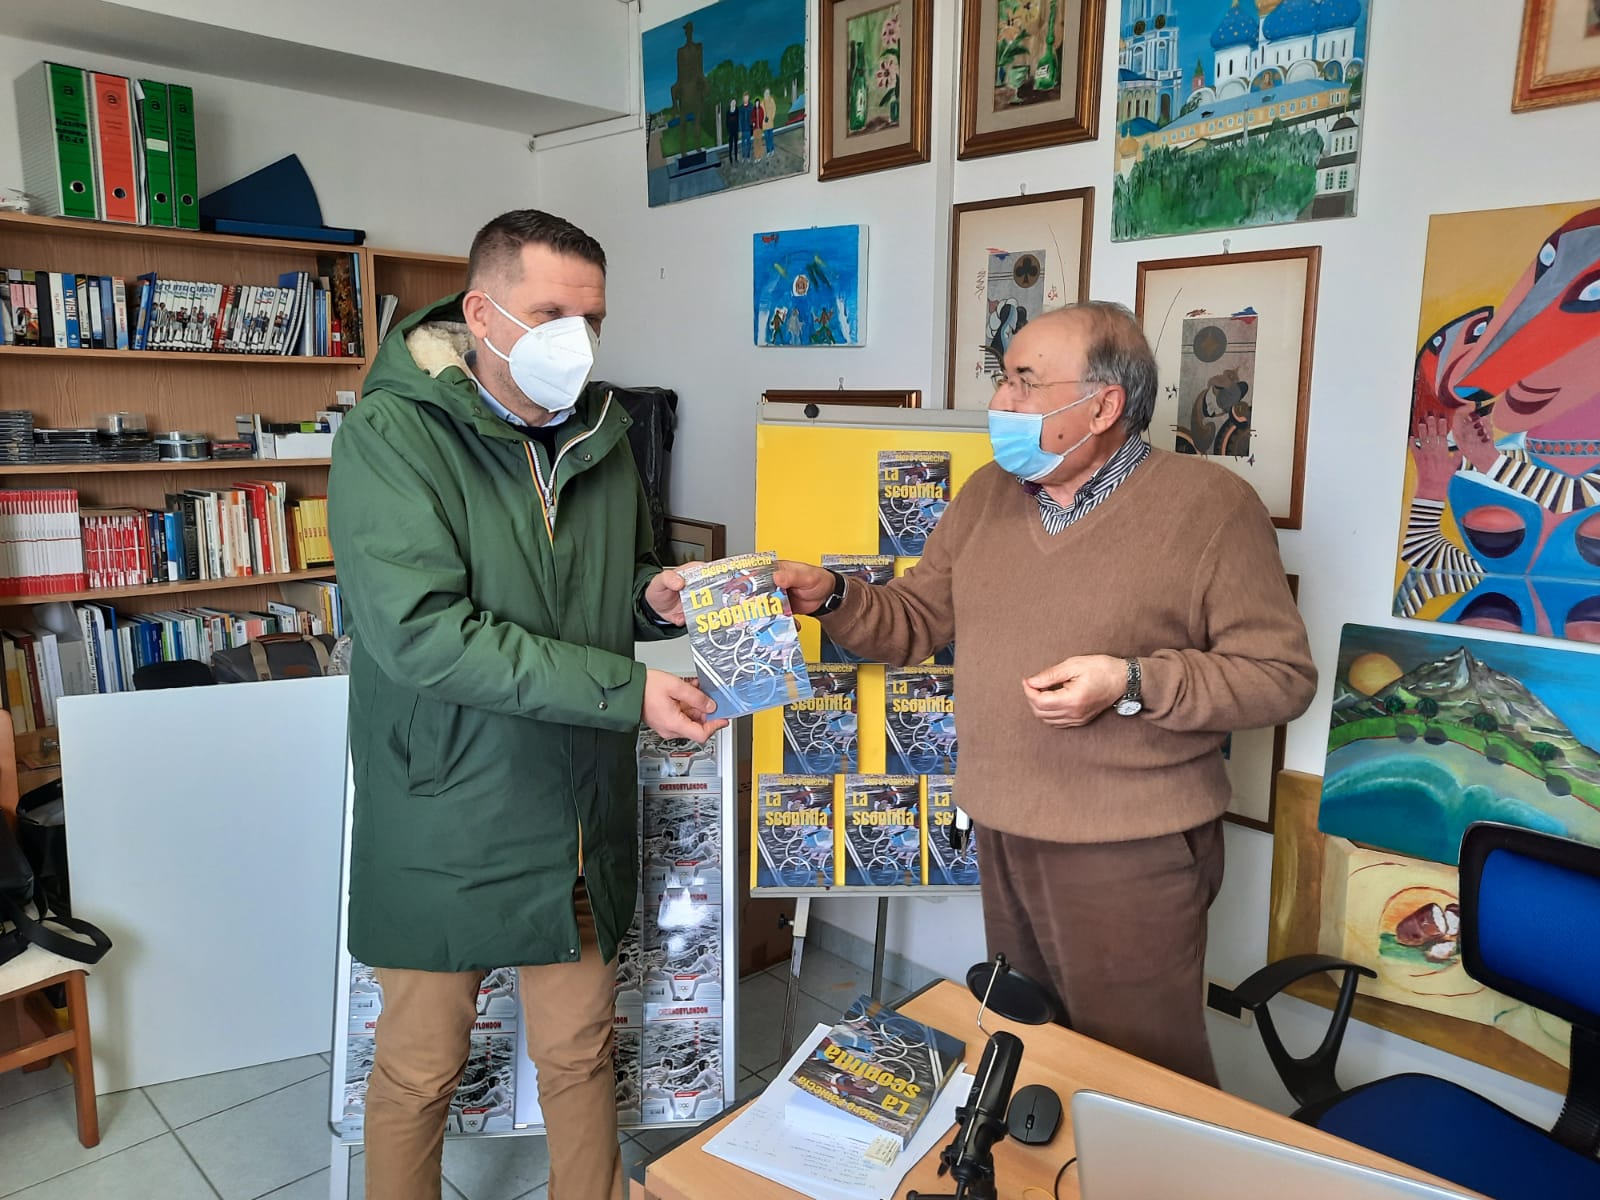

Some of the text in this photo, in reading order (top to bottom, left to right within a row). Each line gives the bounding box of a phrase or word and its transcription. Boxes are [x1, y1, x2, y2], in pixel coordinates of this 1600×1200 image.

[65, 297, 77, 321] VIGILE
[884, 466, 899, 481] La
[884, 483, 943, 499] sconfitta
[689, 587, 714, 610] La
[695, 595, 784, 634] sconfitta
[893, 680, 908, 695] La
[765, 791, 782, 807] La
[852, 791, 868, 807] La
[934, 791, 950, 807] La
[765, 811, 828, 827] sconfitta
[852, 811, 915, 826] sconfitta
[824, 1044, 920, 1098] sconfitta
[881, 1094, 910, 1117] La
